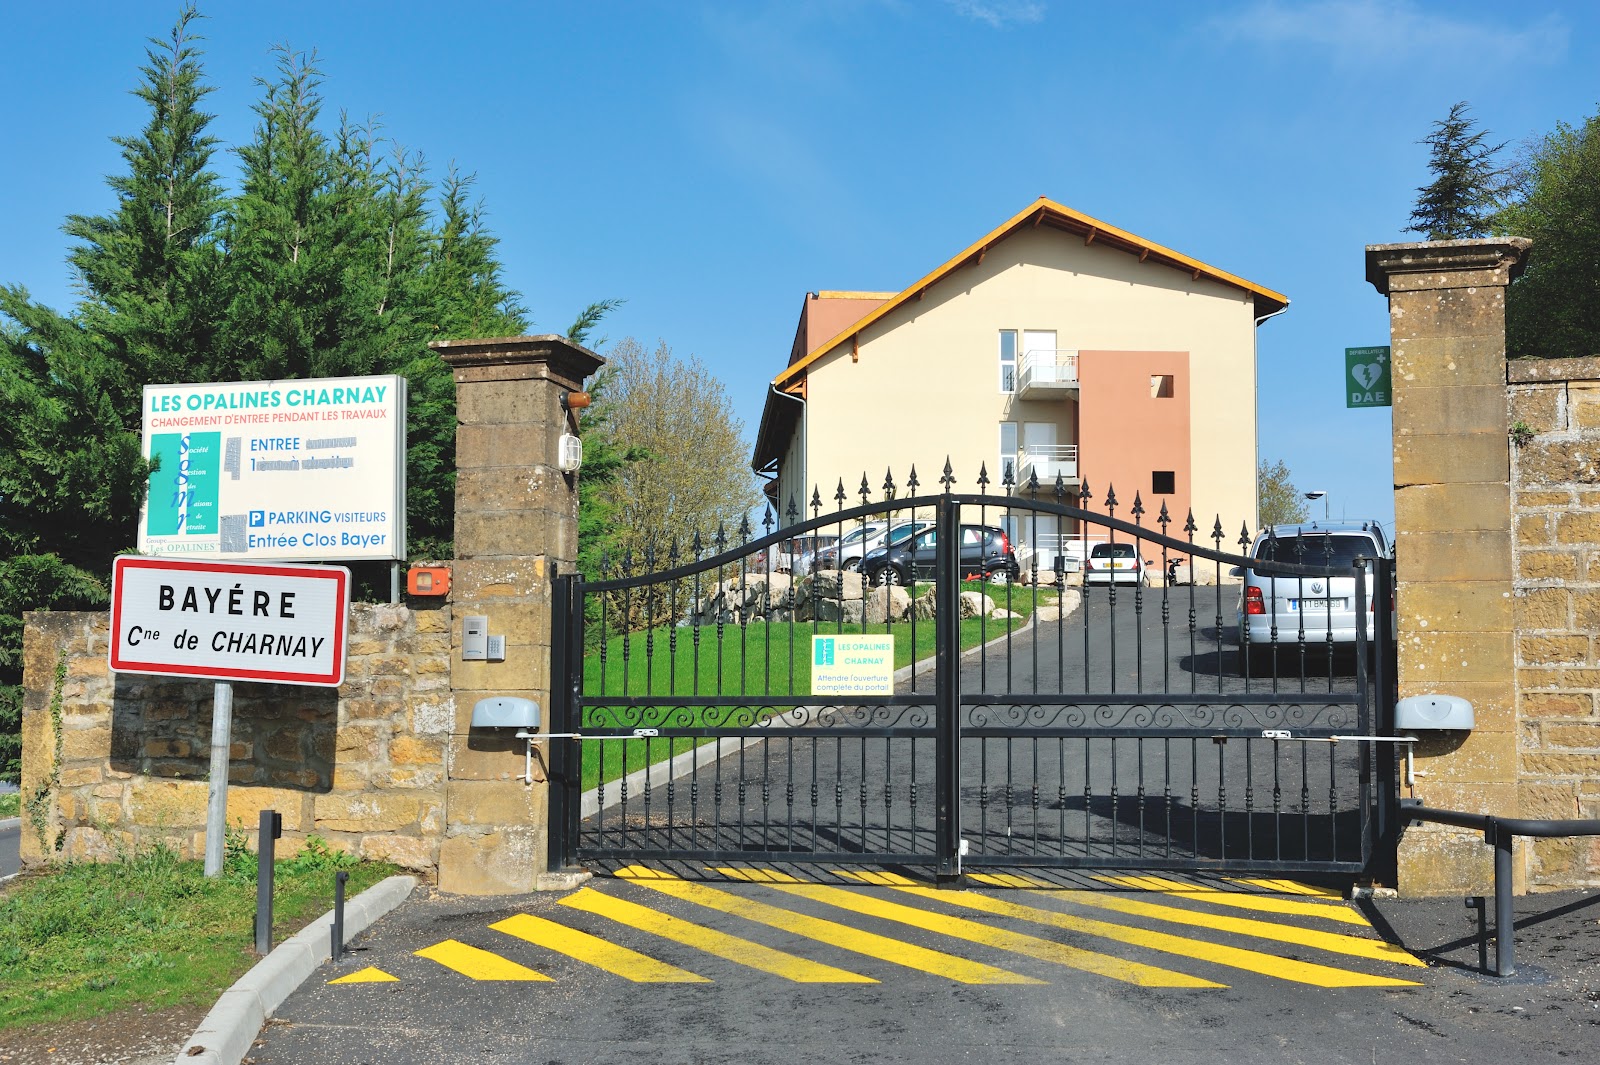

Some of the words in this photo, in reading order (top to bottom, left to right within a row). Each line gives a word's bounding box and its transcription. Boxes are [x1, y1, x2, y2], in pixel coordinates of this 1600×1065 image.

[152, 395, 181, 412] LES
[187, 390, 281, 411] OPALINES
[286, 386, 387, 407] CHARNAY
[1352, 391, 1385, 402] DAE
[151, 415, 222, 428] CHANGEMENT
[225, 413, 269, 425] D'ENTREE
[272, 412, 319, 423] PENDANT
[322, 411, 338, 421] LES
[341, 409, 387, 420] TRAVAUX
[250, 437, 300, 451] ENTREE
[269, 510, 332, 525] PARKING
[334, 511, 386, 523] VISITEURS
[249, 532, 298, 548] Entrée
[302, 532, 337, 547] Clos
[341, 532, 386, 549] Bayer
[158, 583, 296, 619] BAYÉRE
[173, 629, 199, 650] de
[211, 631, 324, 658] CHARNAY
[838, 643, 851, 651] LES
[852, 643, 890, 651] OPALINES
[844, 657, 884, 665] CHARNAY
[817, 674, 849, 682] Attendre
[850, 674, 888, 682] l'ouverture
